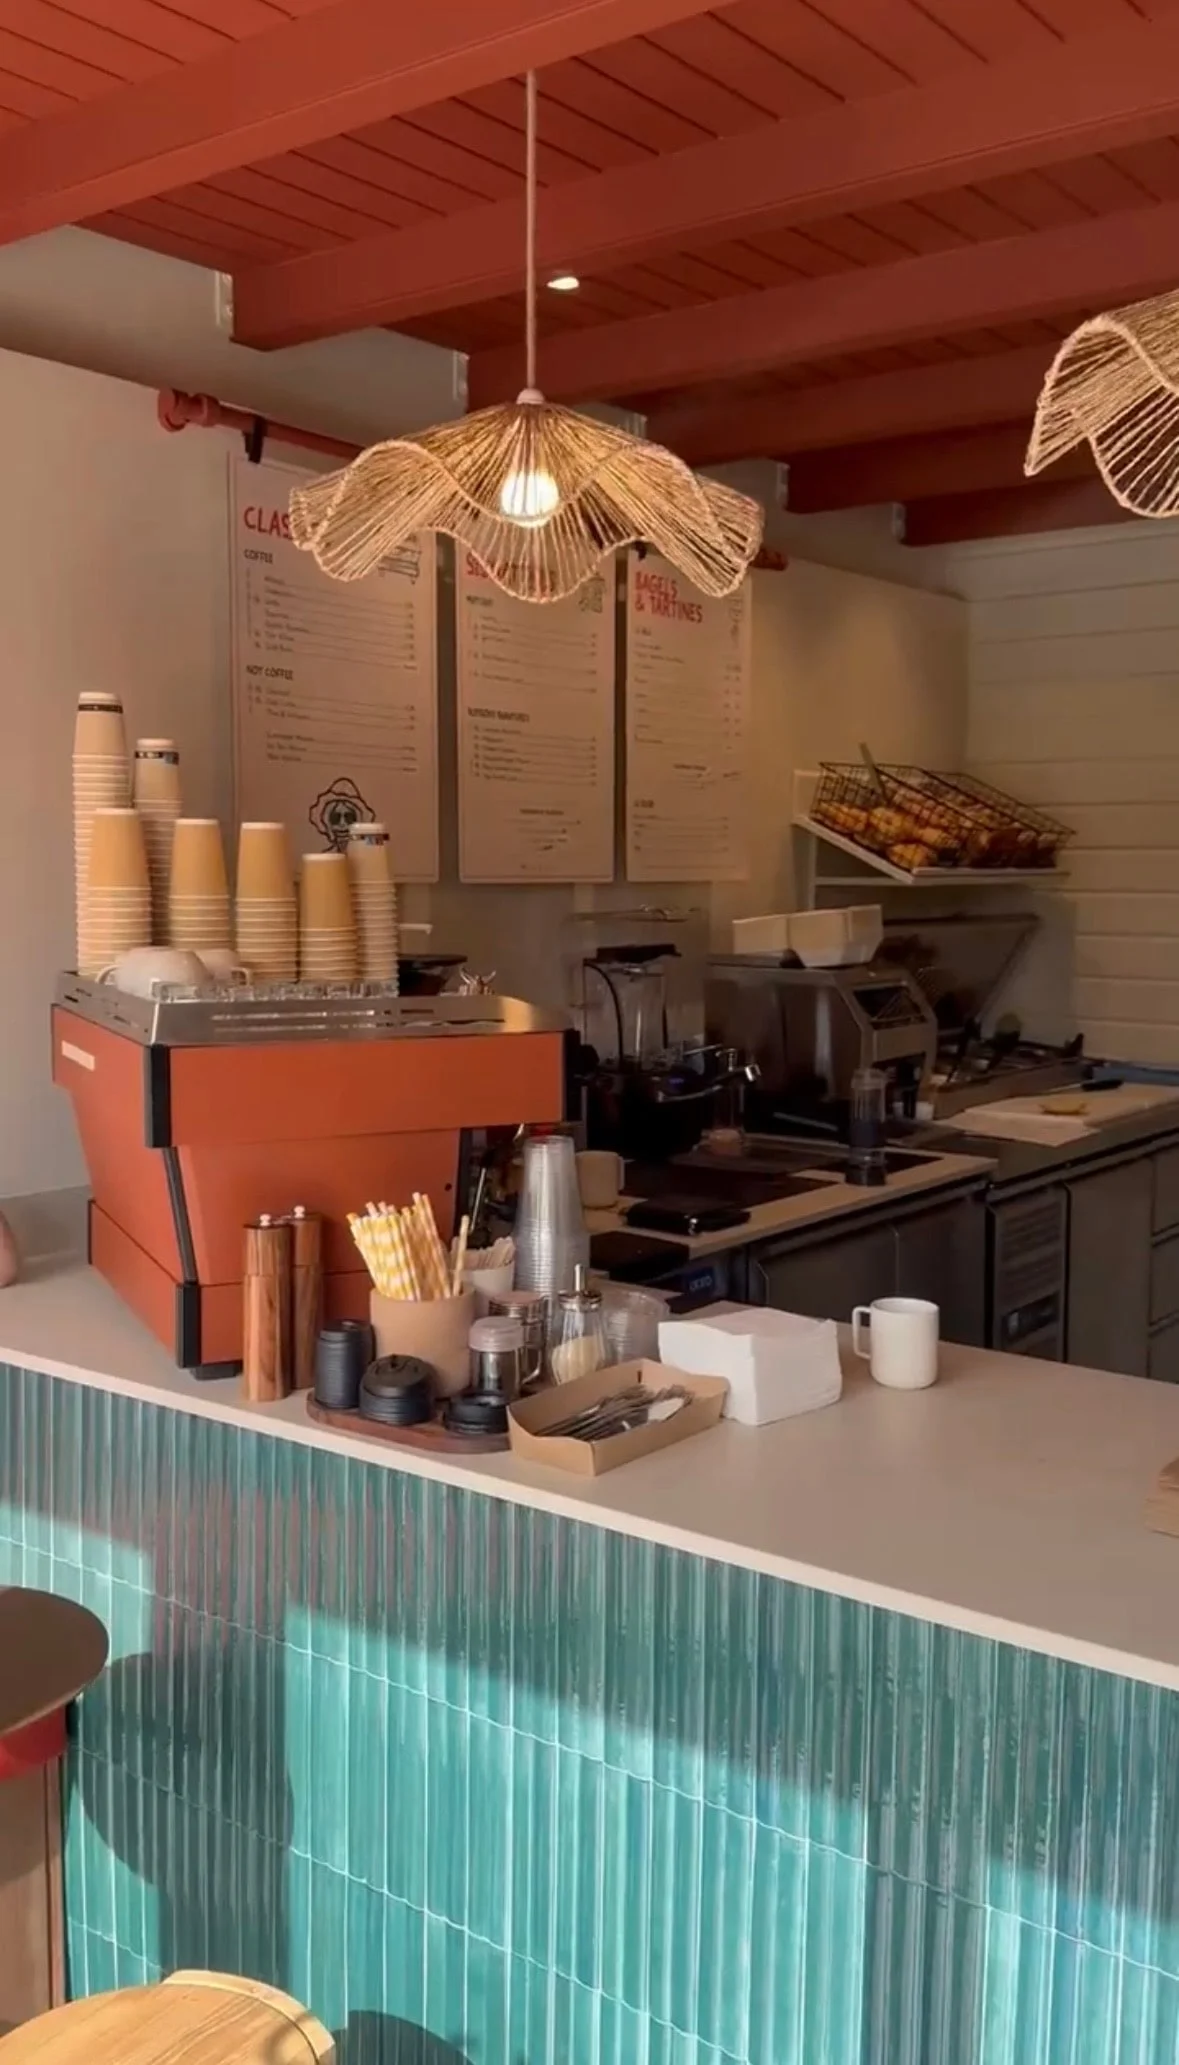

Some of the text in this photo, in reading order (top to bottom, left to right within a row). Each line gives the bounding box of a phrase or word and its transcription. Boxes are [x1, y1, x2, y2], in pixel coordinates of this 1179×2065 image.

[243, 548, 273, 565] COFFEE
[635, 571, 678, 598] BAGELS
[634, 593, 703, 624] & TARTINES
[246, 664, 294, 681] NOT COFFEE
